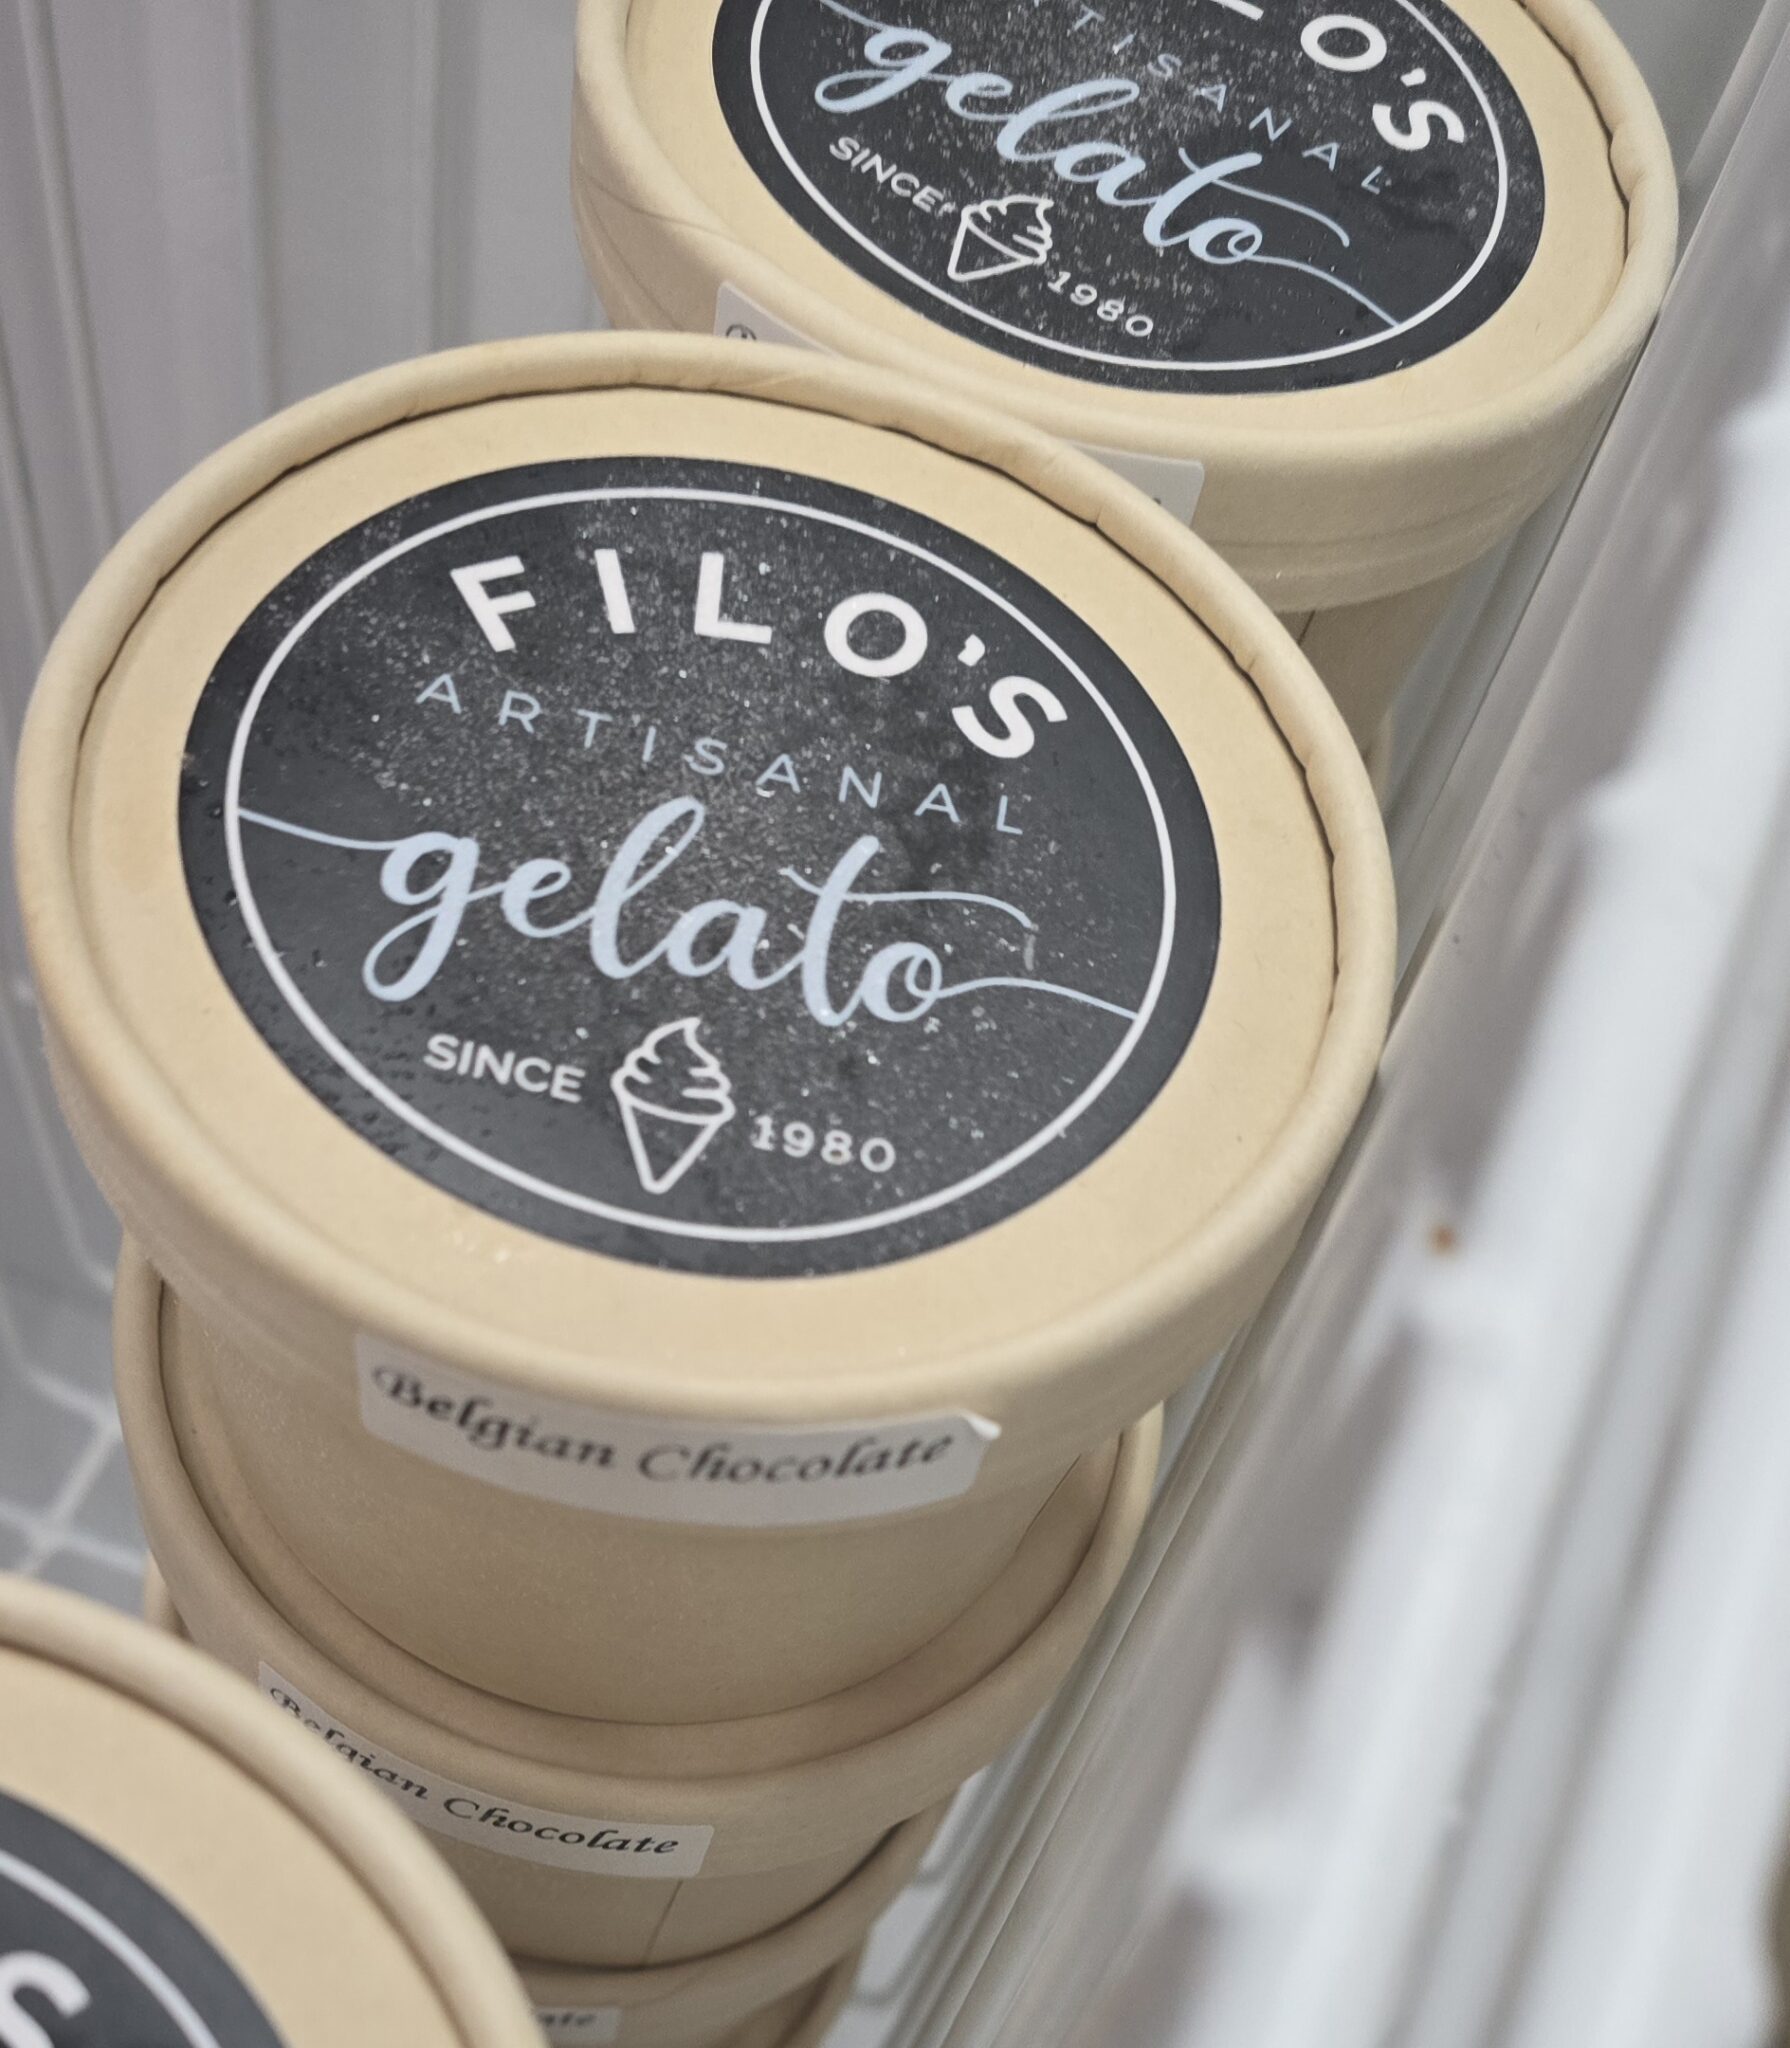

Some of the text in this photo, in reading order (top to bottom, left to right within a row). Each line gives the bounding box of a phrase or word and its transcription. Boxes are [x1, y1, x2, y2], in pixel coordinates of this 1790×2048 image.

[815, 25, 1348, 265] gelato
[830, 137, 1153, 337] SINCE 1980
[450, 548, 1067, 758] FILO'S
[416, 674, 1023, 835] ARTISANAL
[363, 797, 1037, 1026] gelato
[424, 1034, 896, 1173] SINCE 1980
[371, 1364, 954, 1483] Belgian Chocolate
[443, 1798, 679, 1853] Chocolate
